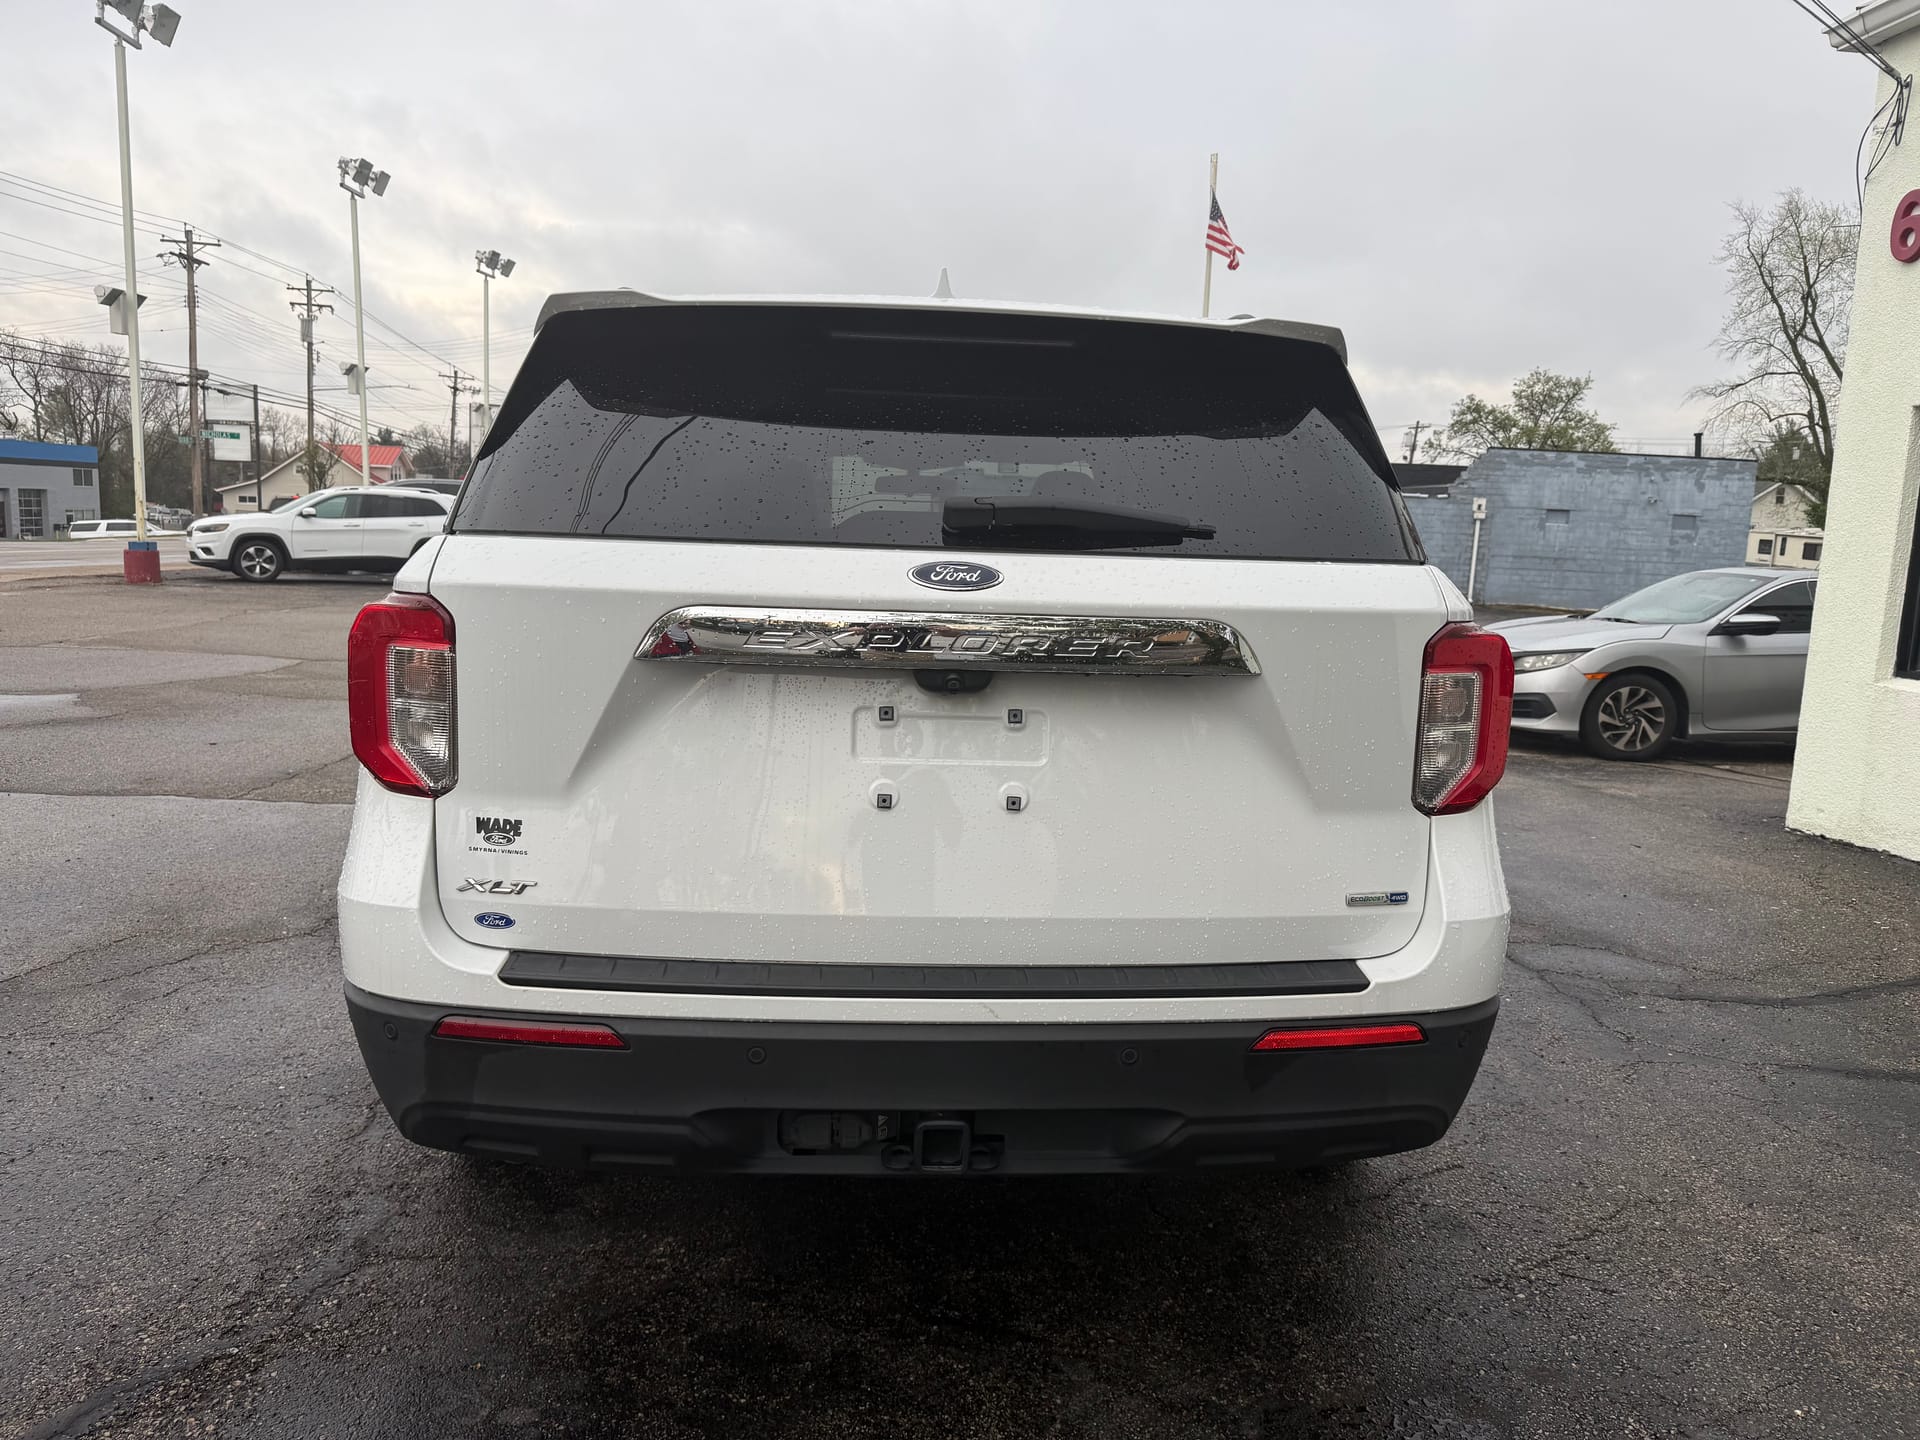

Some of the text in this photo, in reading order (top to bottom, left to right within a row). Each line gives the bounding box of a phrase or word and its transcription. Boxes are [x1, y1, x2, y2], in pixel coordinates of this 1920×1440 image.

[1890, 188, 1920, 263] 6
[930, 564, 982, 582] Ford
[743, 628, 1156, 658] EXPLORER
[475, 816, 523, 837] WADE
[456, 877, 538, 895] XLT
[482, 913, 506, 926] Ford
